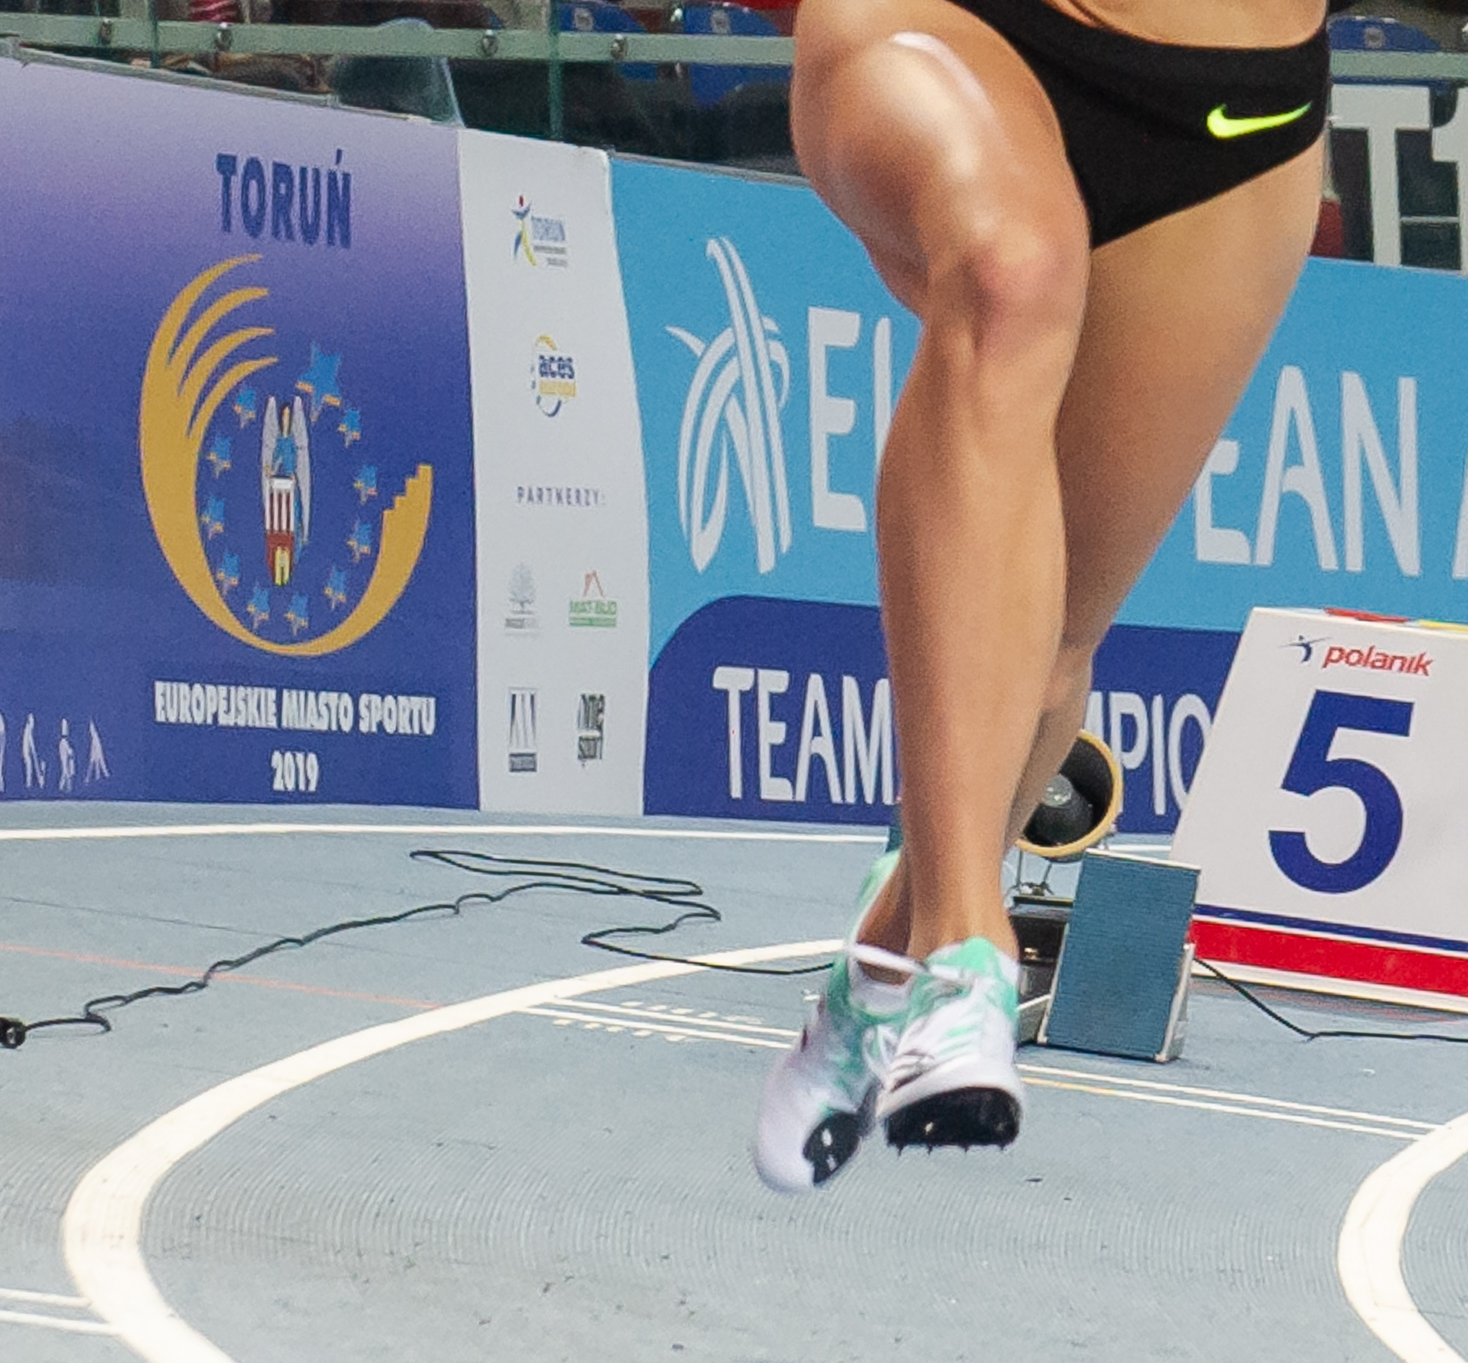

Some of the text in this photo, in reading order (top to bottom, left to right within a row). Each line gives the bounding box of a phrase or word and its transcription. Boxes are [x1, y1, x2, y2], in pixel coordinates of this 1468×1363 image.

[216, 147, 351, 249] TORUŃ
[1322, 644, 1434, 676] polanik
[154, 680, 437, 735] EUROPEJSKIE MIASTO SPORTU
[712, 666, 898, 805] TEAM
[270, 750, 320, 792] 2019
[1268, 689, 1415, 894] 5
